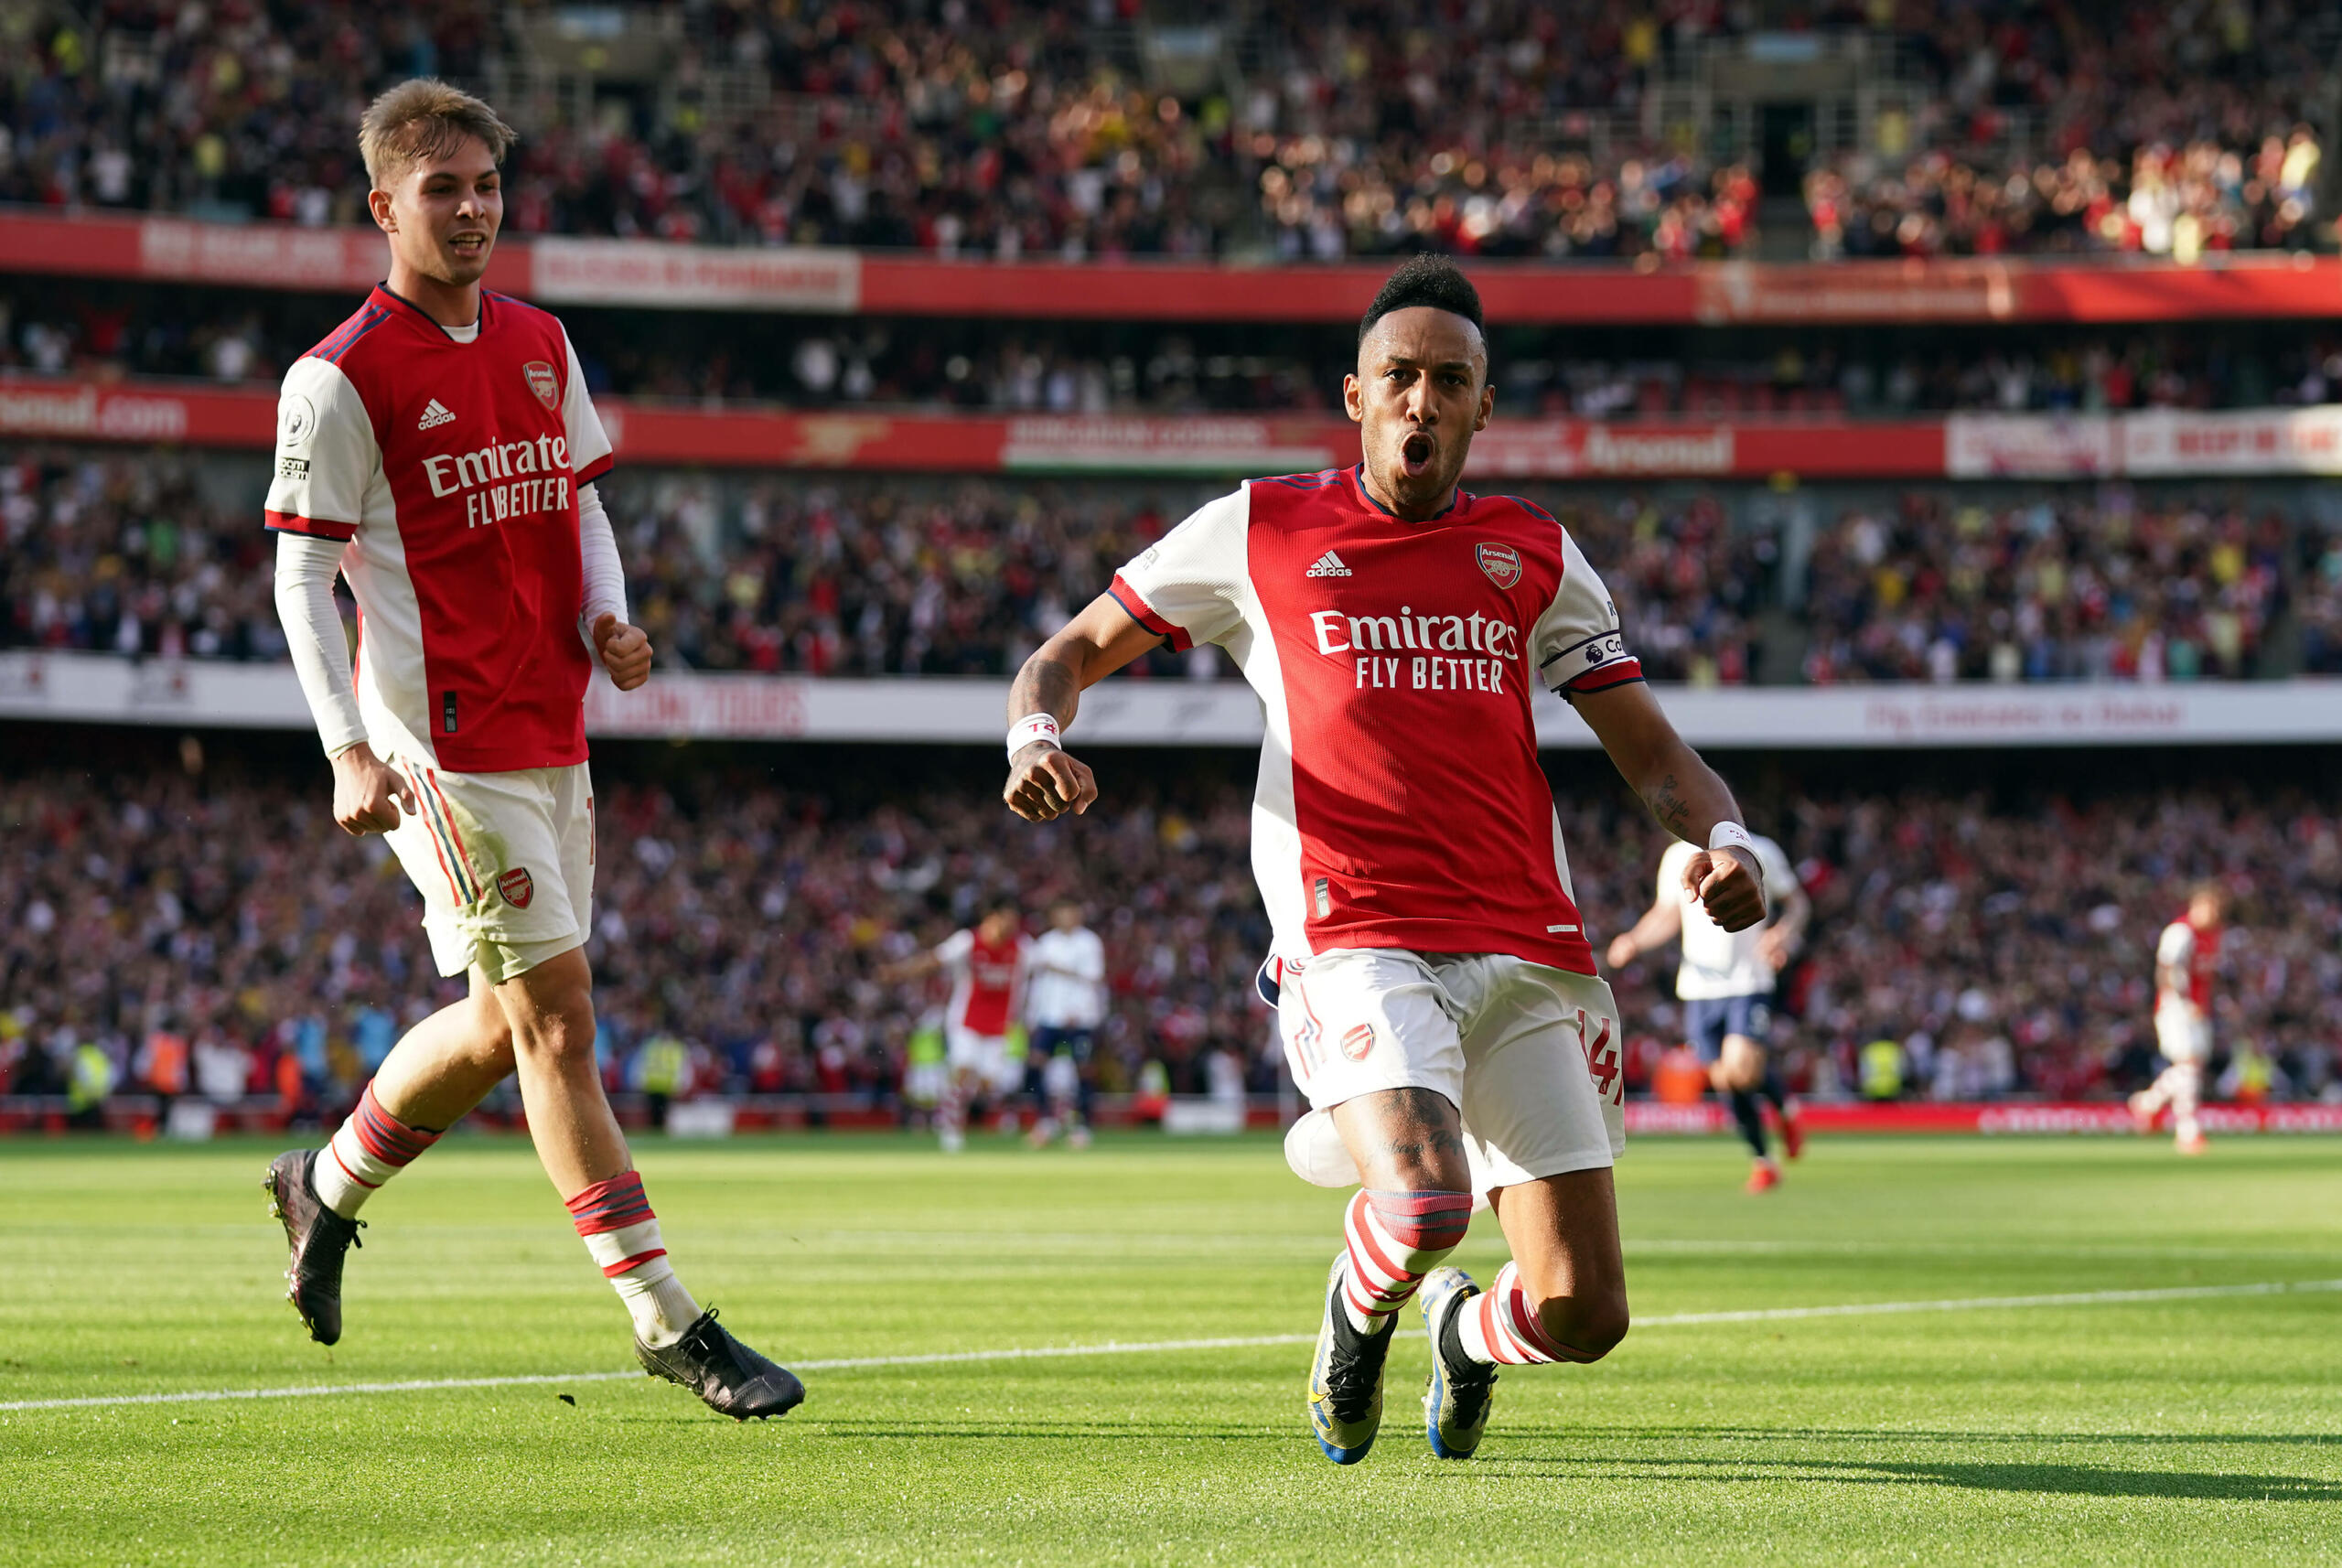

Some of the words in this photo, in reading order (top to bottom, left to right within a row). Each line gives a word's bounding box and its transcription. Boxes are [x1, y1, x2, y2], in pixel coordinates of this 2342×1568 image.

[418, 412, 457, 431] adidas
[422, 431, 573, 498] Emirate
[497, 477, 569, 520] BETTER
[1305, 566, 1353, 578] adidas
[1482, 549, 1515, 561] Arsenal
[1309, 606, 1519, 660] Emirates
[1356, 656, 1400, 689] FLY
[1413, 656, 1504, 694] BETTER
